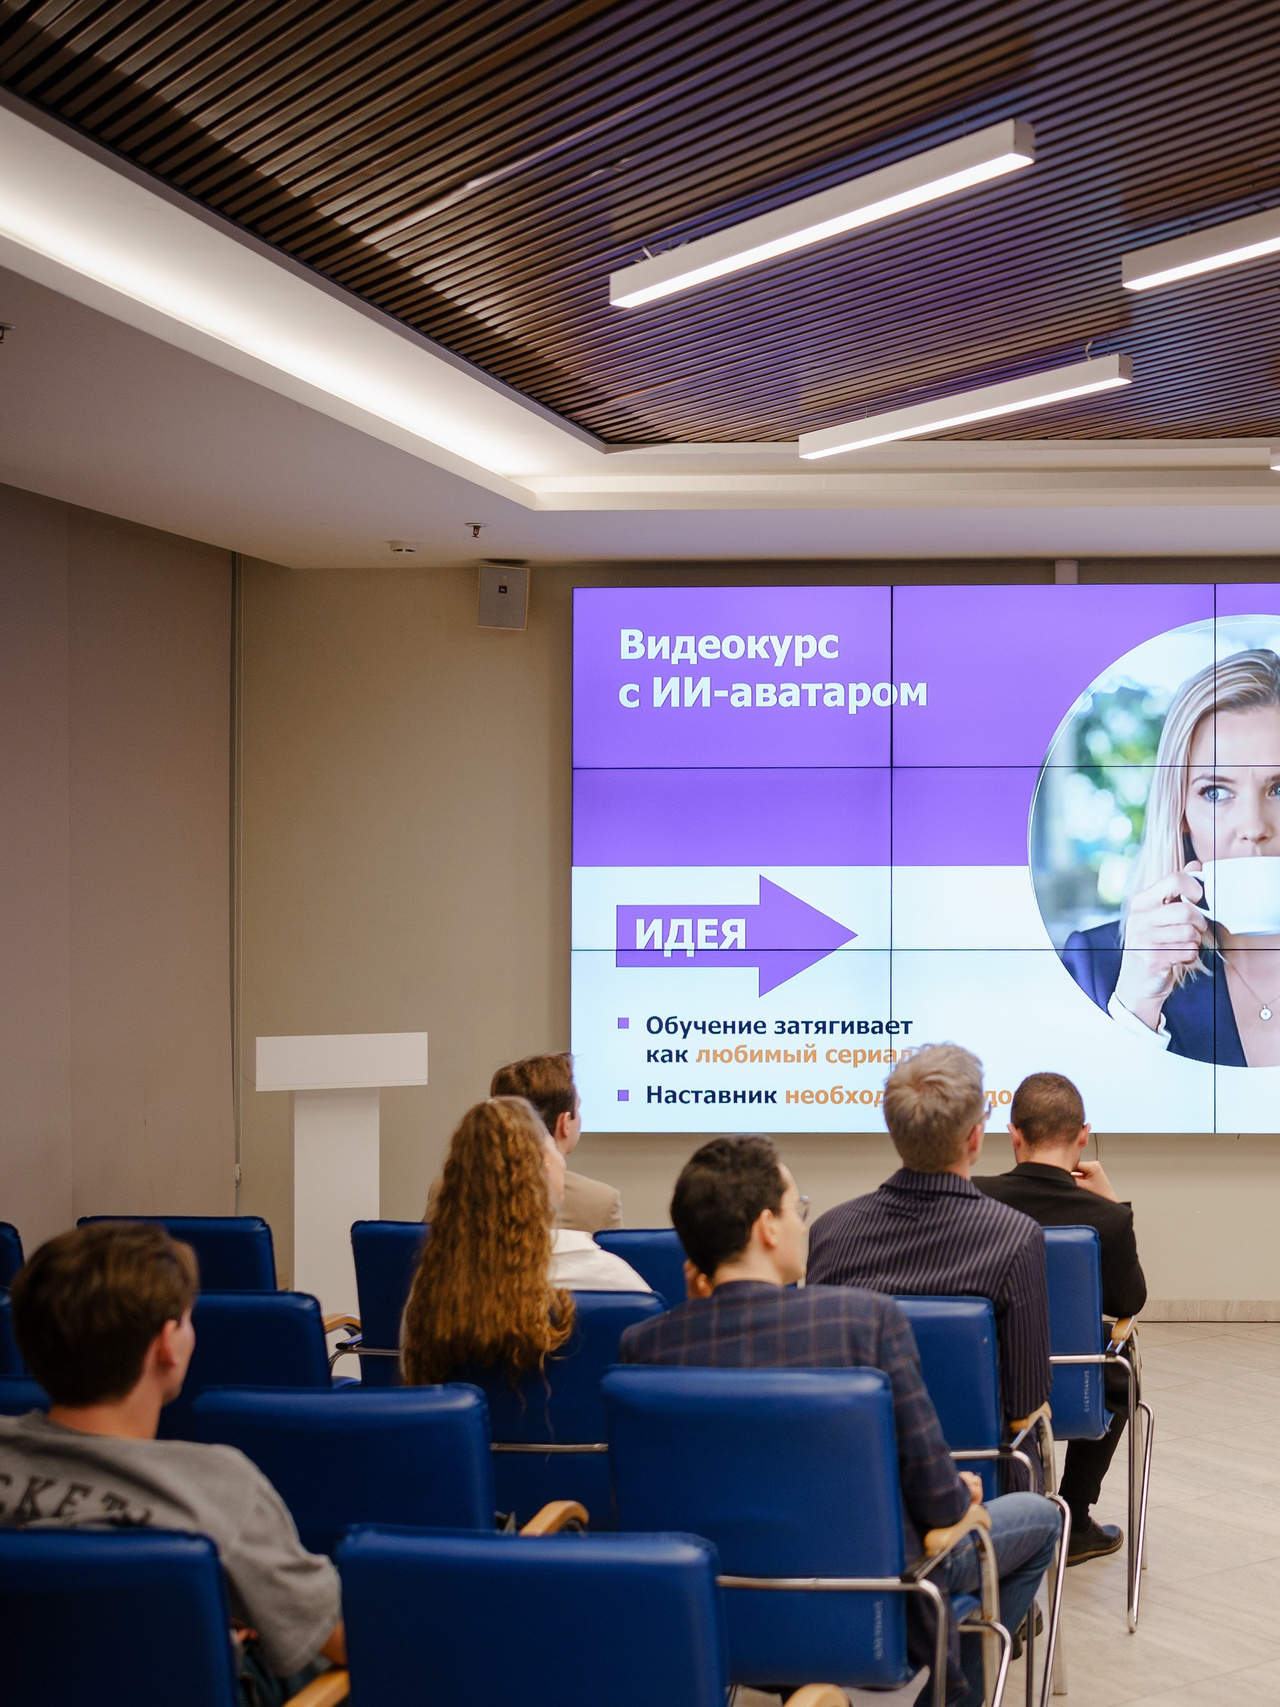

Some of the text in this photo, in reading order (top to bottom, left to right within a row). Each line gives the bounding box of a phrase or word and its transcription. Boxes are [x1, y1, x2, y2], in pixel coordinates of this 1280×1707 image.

[619, 628, 840, 667] Видеокурс
[618, 676, 929, 715] с ИИ-аватаром
[635, 918, 747, 957] ИДЕЯ
[645, 1015, 914, 1039] Обучение затягивает
[645, 1046, 689, 1064] как
[695, 1043, 818, 1064] любимый
[646, 1085, 777, 1105] Наставник
[785, 1085, 885, 1108] необход
